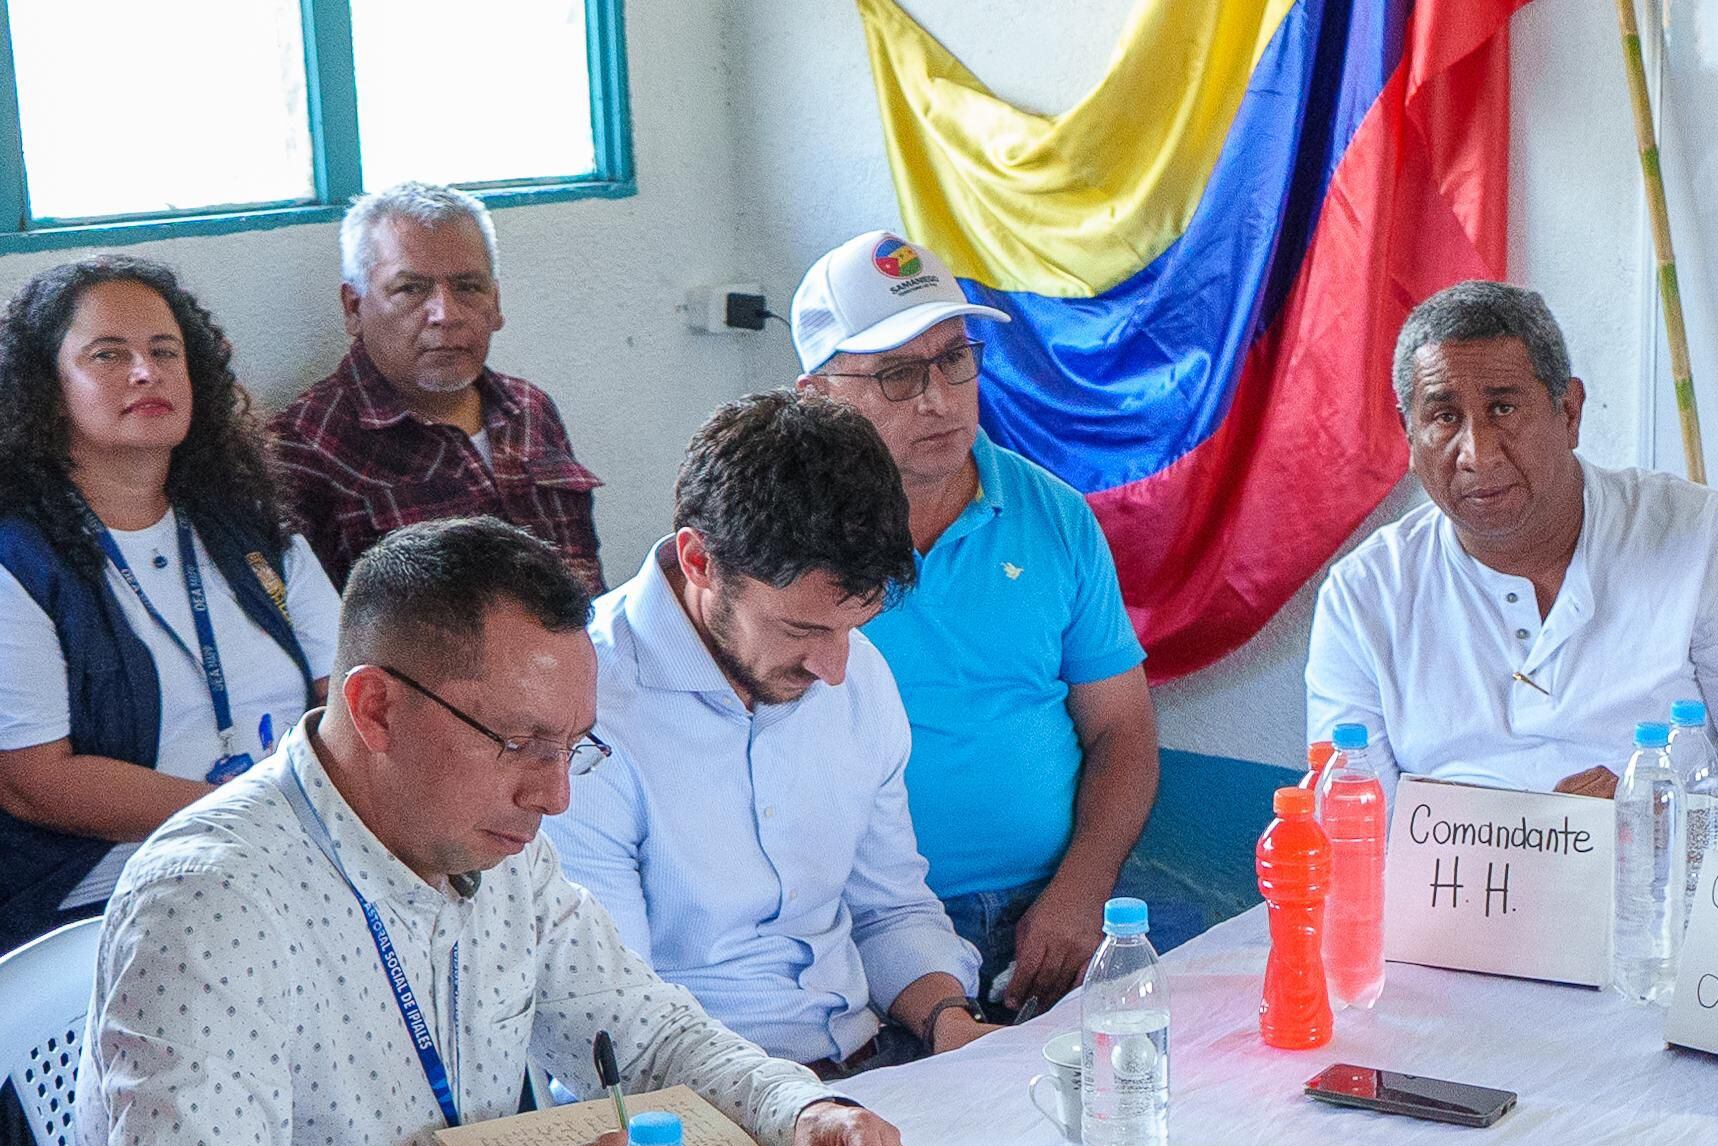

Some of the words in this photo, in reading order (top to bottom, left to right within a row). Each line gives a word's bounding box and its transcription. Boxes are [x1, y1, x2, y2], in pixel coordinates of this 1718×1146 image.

[1410, 804, 1594, 855] Comandante
[1430, 856, 1469, 908] H.
[1486, 862, 1516, 917] H.
[364, 902, 393, 952] ASTORAL
[384, 952, 407, 993] SOCIAL
[401, 992, 415, 1010] DE
[406, 1008, 433, 1050] IPIALES
